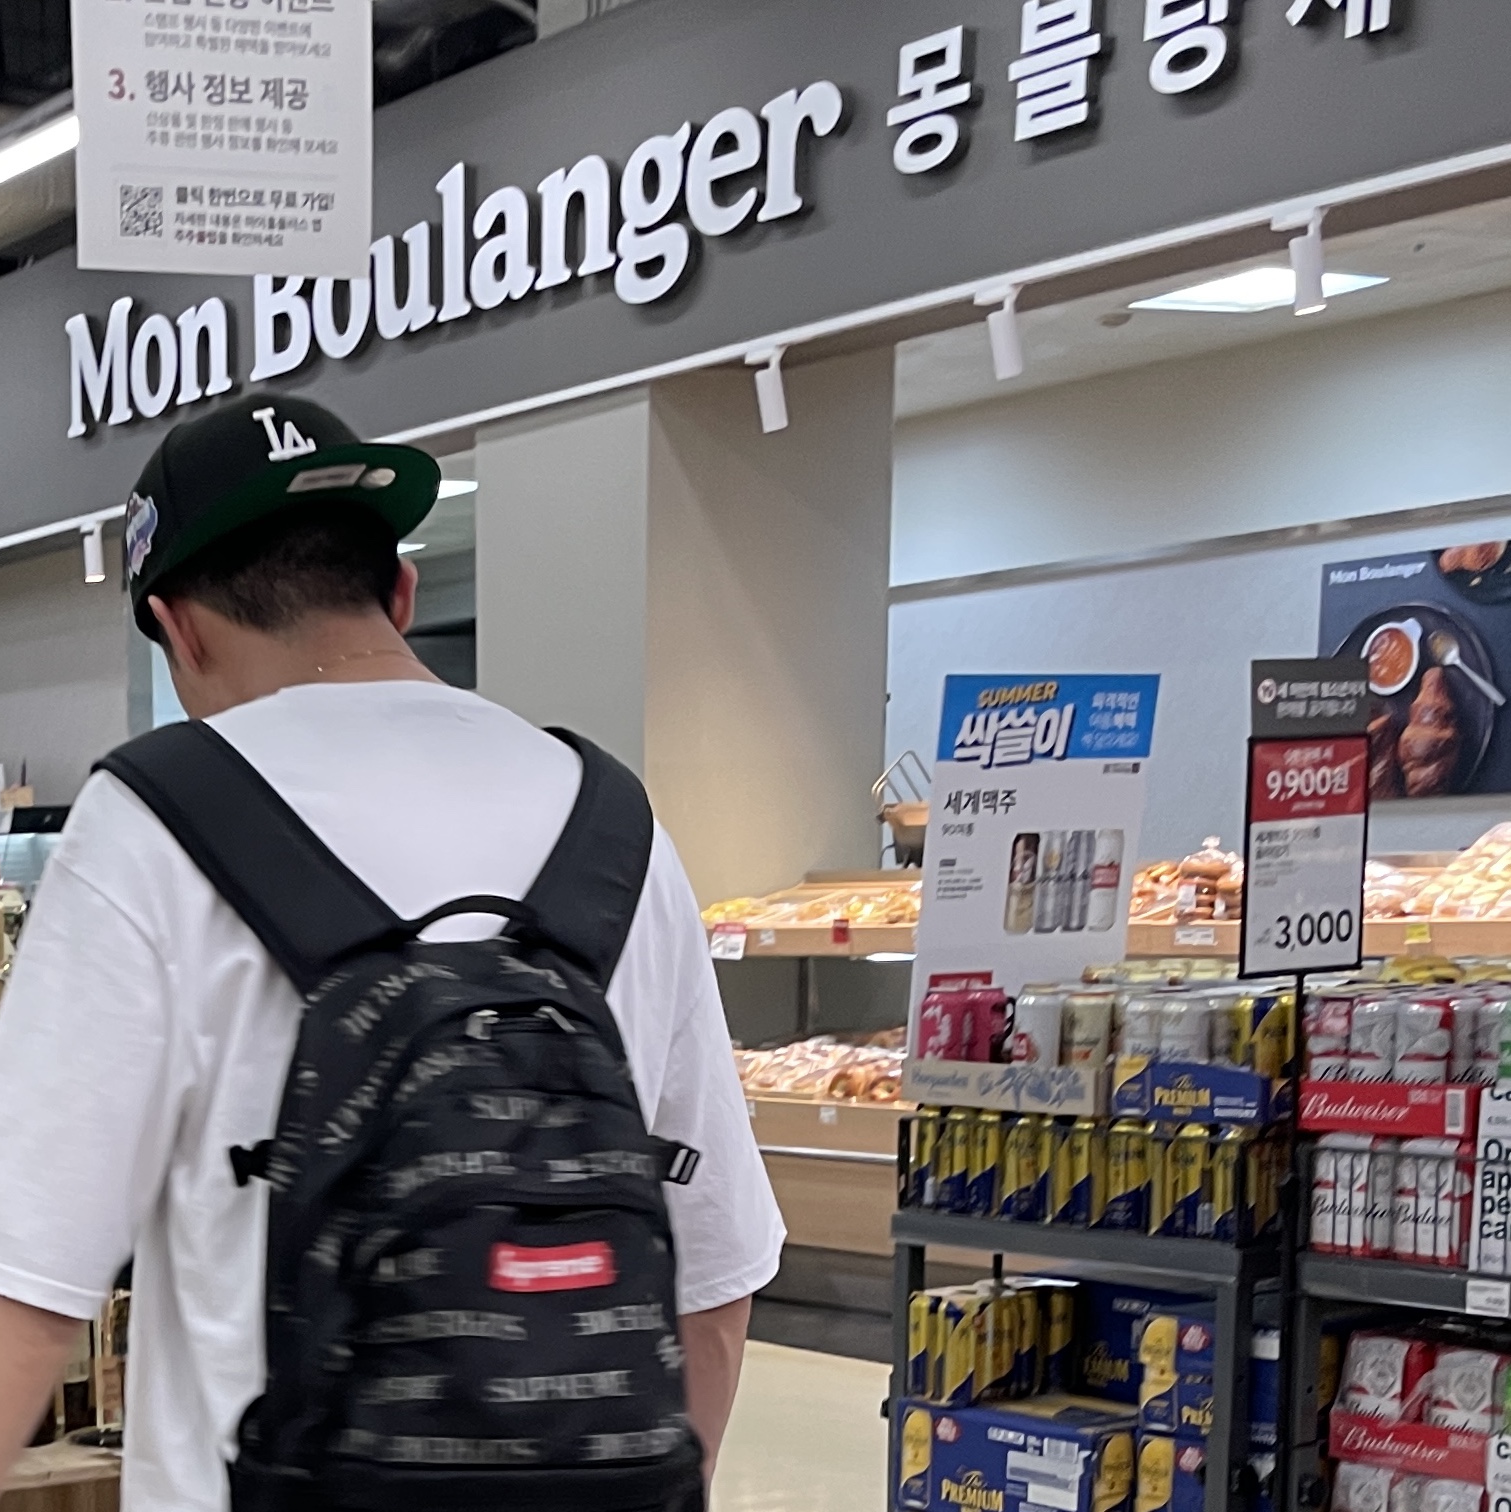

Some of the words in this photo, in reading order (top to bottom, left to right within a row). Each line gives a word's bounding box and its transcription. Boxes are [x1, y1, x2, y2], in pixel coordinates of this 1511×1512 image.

[108, 68, 135, 101] 3.
[145, 70, 195, 105] 행사
[203, 74, 254, 107] 정보
[260, 77, 310, 111] 제공
[64, 297, 233, 438] Mon
[249, 79, 843, 384] Boulanger
[252, 406, 317, 462] LA
[977, 680, 1059, 709] SUMMER
[952, 703, 1076, 769] 싹쓸이
[943, 788, 1017, 816] 세계맥주
[1266, 764, 1350, 802] 9,900원
[1275, 909, 1353, 952] 3,000
[1154, 1086, 1212, 1107] PREMIUM
[1300, 1090, 1410, 1122] Budweiser
[1341, 1424, 1450, 1463] Budweiser
